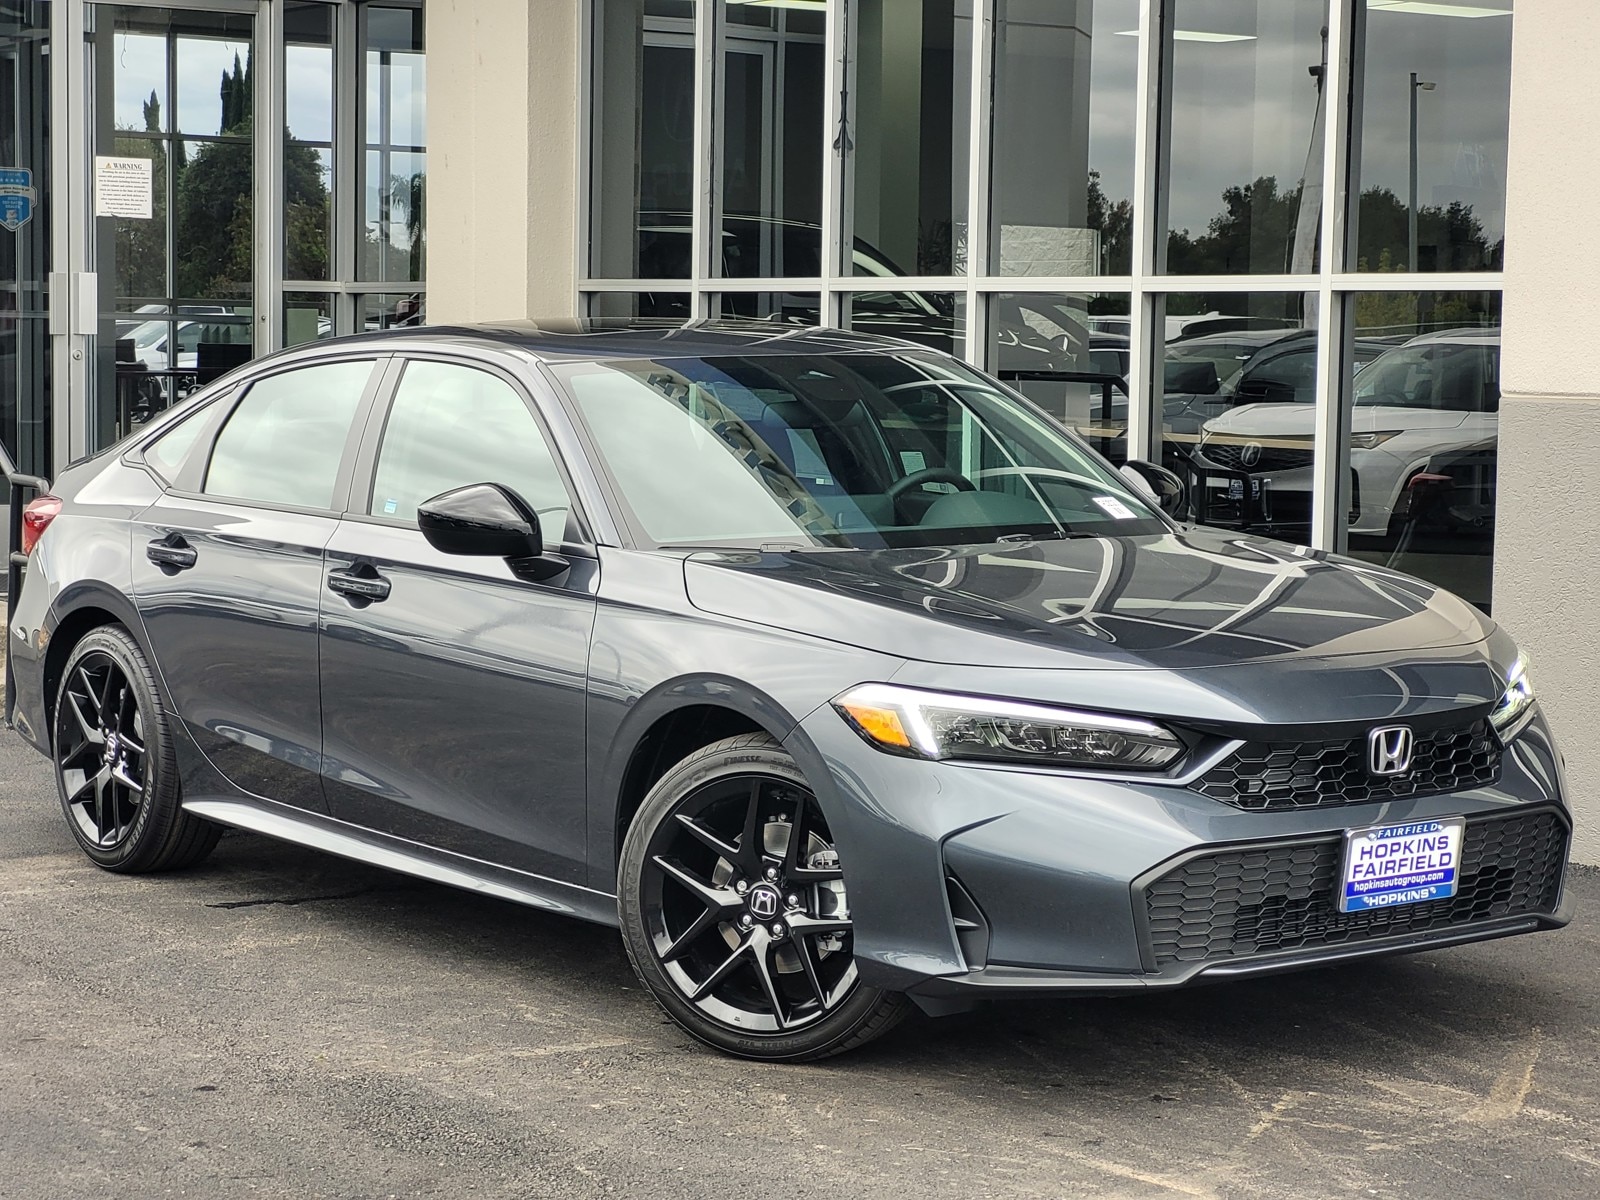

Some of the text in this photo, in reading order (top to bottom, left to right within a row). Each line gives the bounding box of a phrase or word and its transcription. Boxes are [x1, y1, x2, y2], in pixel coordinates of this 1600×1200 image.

[113, 162, 143, 170] WARNING
[1377, 823, 1438, 838] FAIRFIELD
[1360, 835, 1449, 860] HOPKINS
[1352, 852, 1452, 879] FAIRFIELD
[1353, 871, 1444, 892] hopkinsautogroup.com
[1368, 888, 1430, 906] HOPKINS
